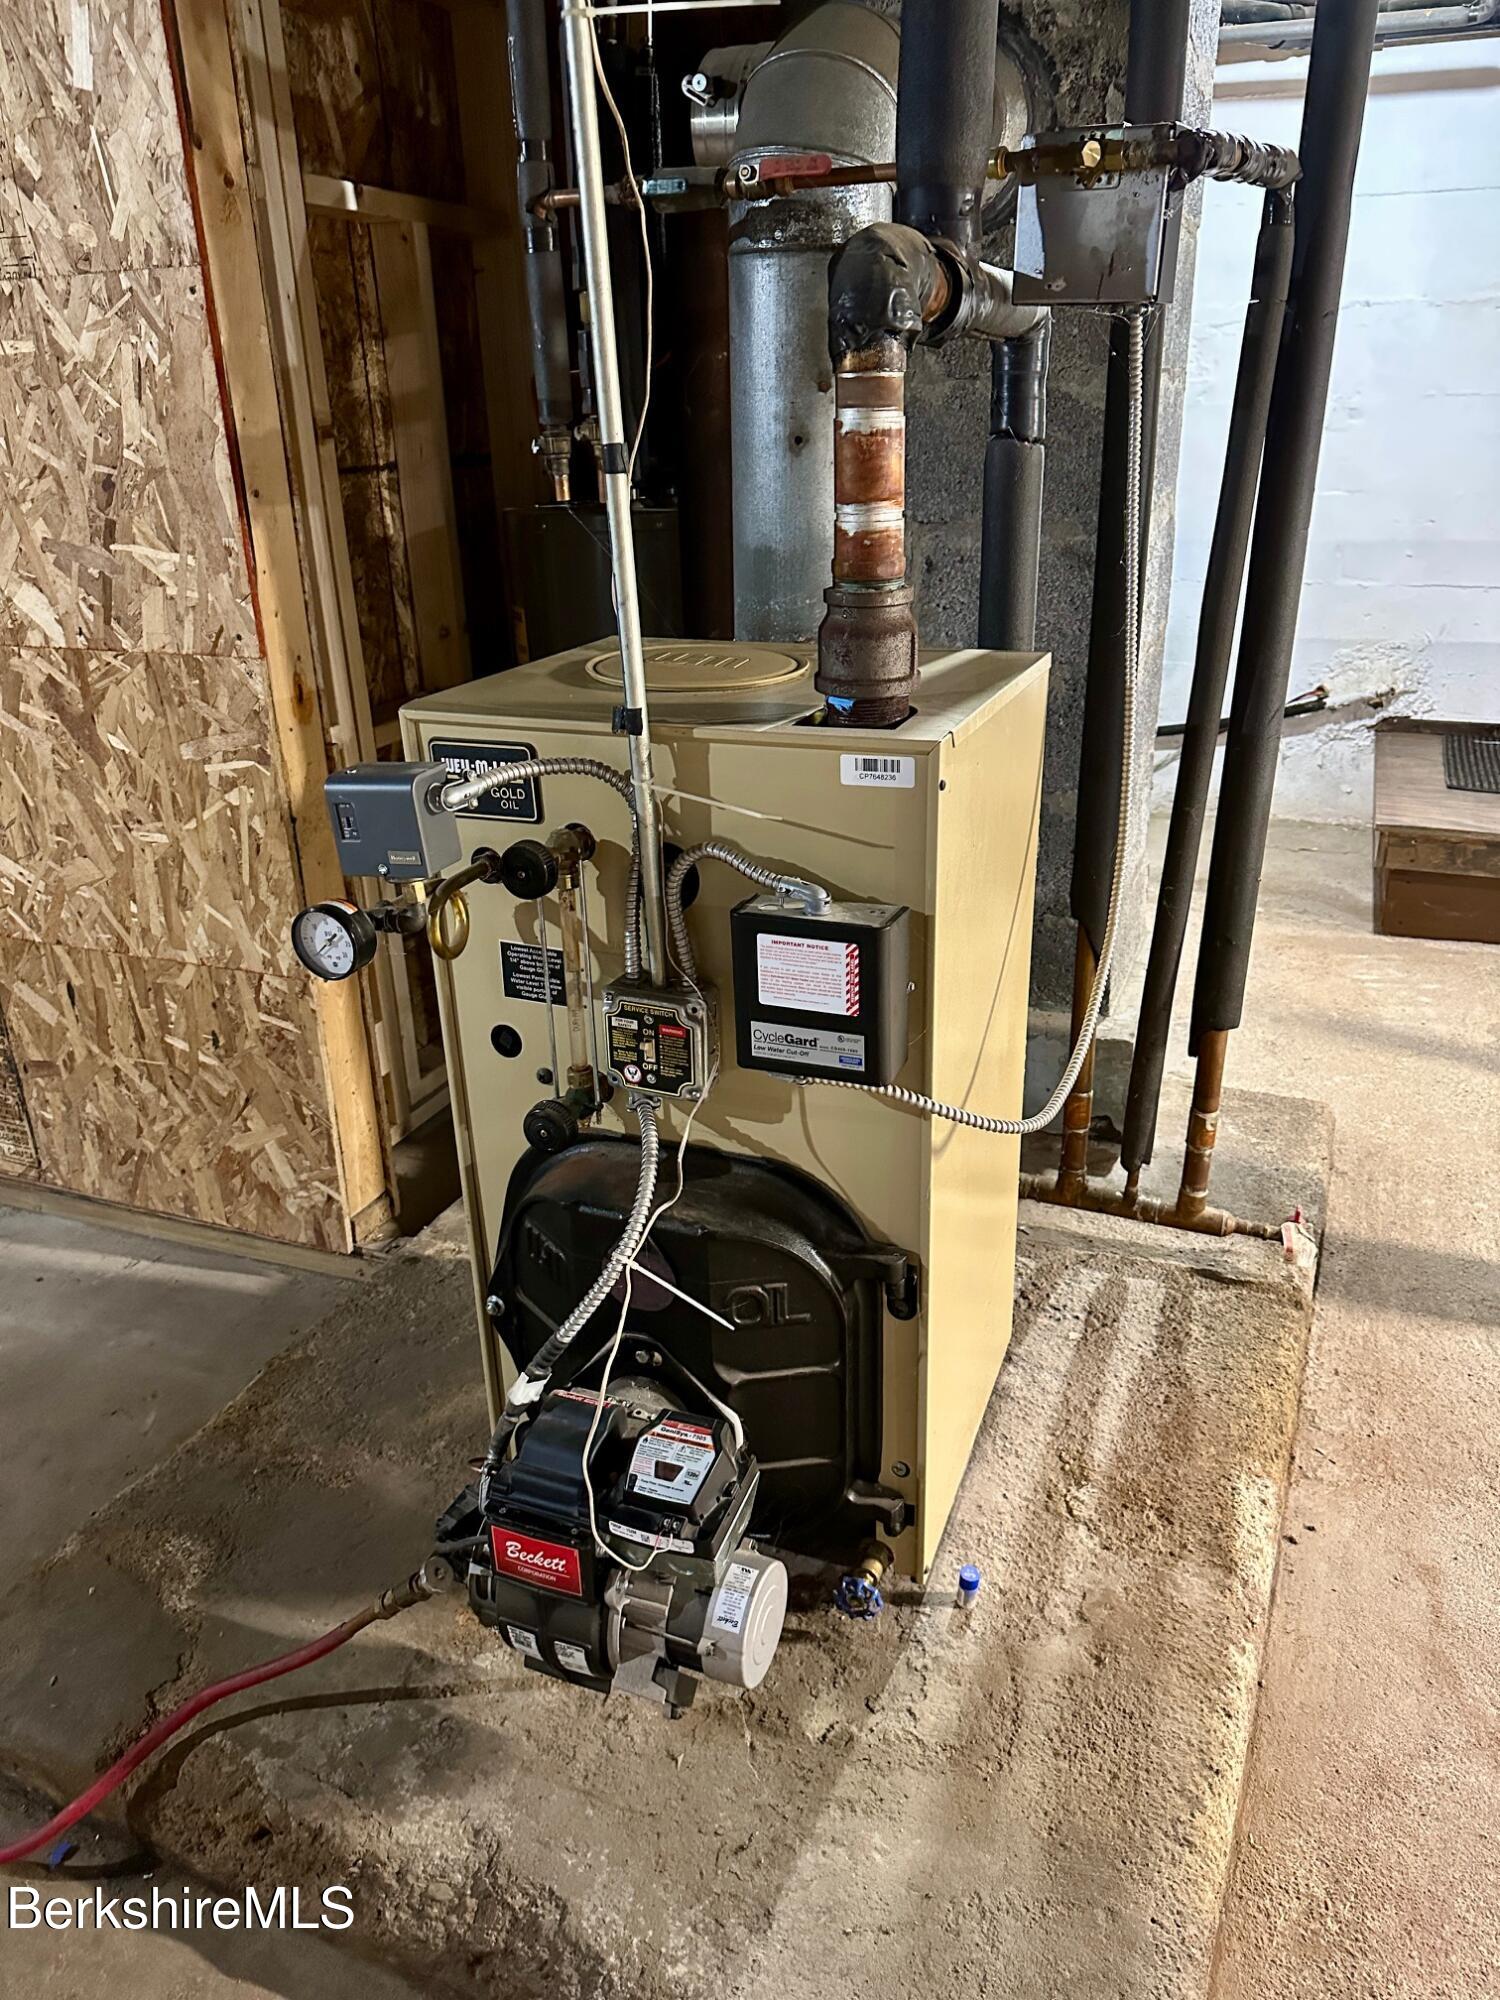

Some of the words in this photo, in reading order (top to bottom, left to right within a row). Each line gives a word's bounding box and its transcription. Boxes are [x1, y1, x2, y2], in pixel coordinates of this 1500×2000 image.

[490, 787, 526, 800] GOLD
[500, 800, 520, 810] OIL
[510, 945, 529, 953] Lowest
[771, 939, 805, 948] IMPORTANT
[507, 951, 532, 960] Operating
[623, 1004, 649, 1014] SERVICE
[650, 1008, 674, 1018] SWITCH
[642, 1028, 655, 1036] ON
[753, 1029, 818, 1048] CycleGard
[642, 1062, 658, 1071] OFF
[727, 1282, 812, 1325] OIL
[505, 1540, 567, 1572] Beckett
[517, 1565, 557, 1582] CORPORATION
